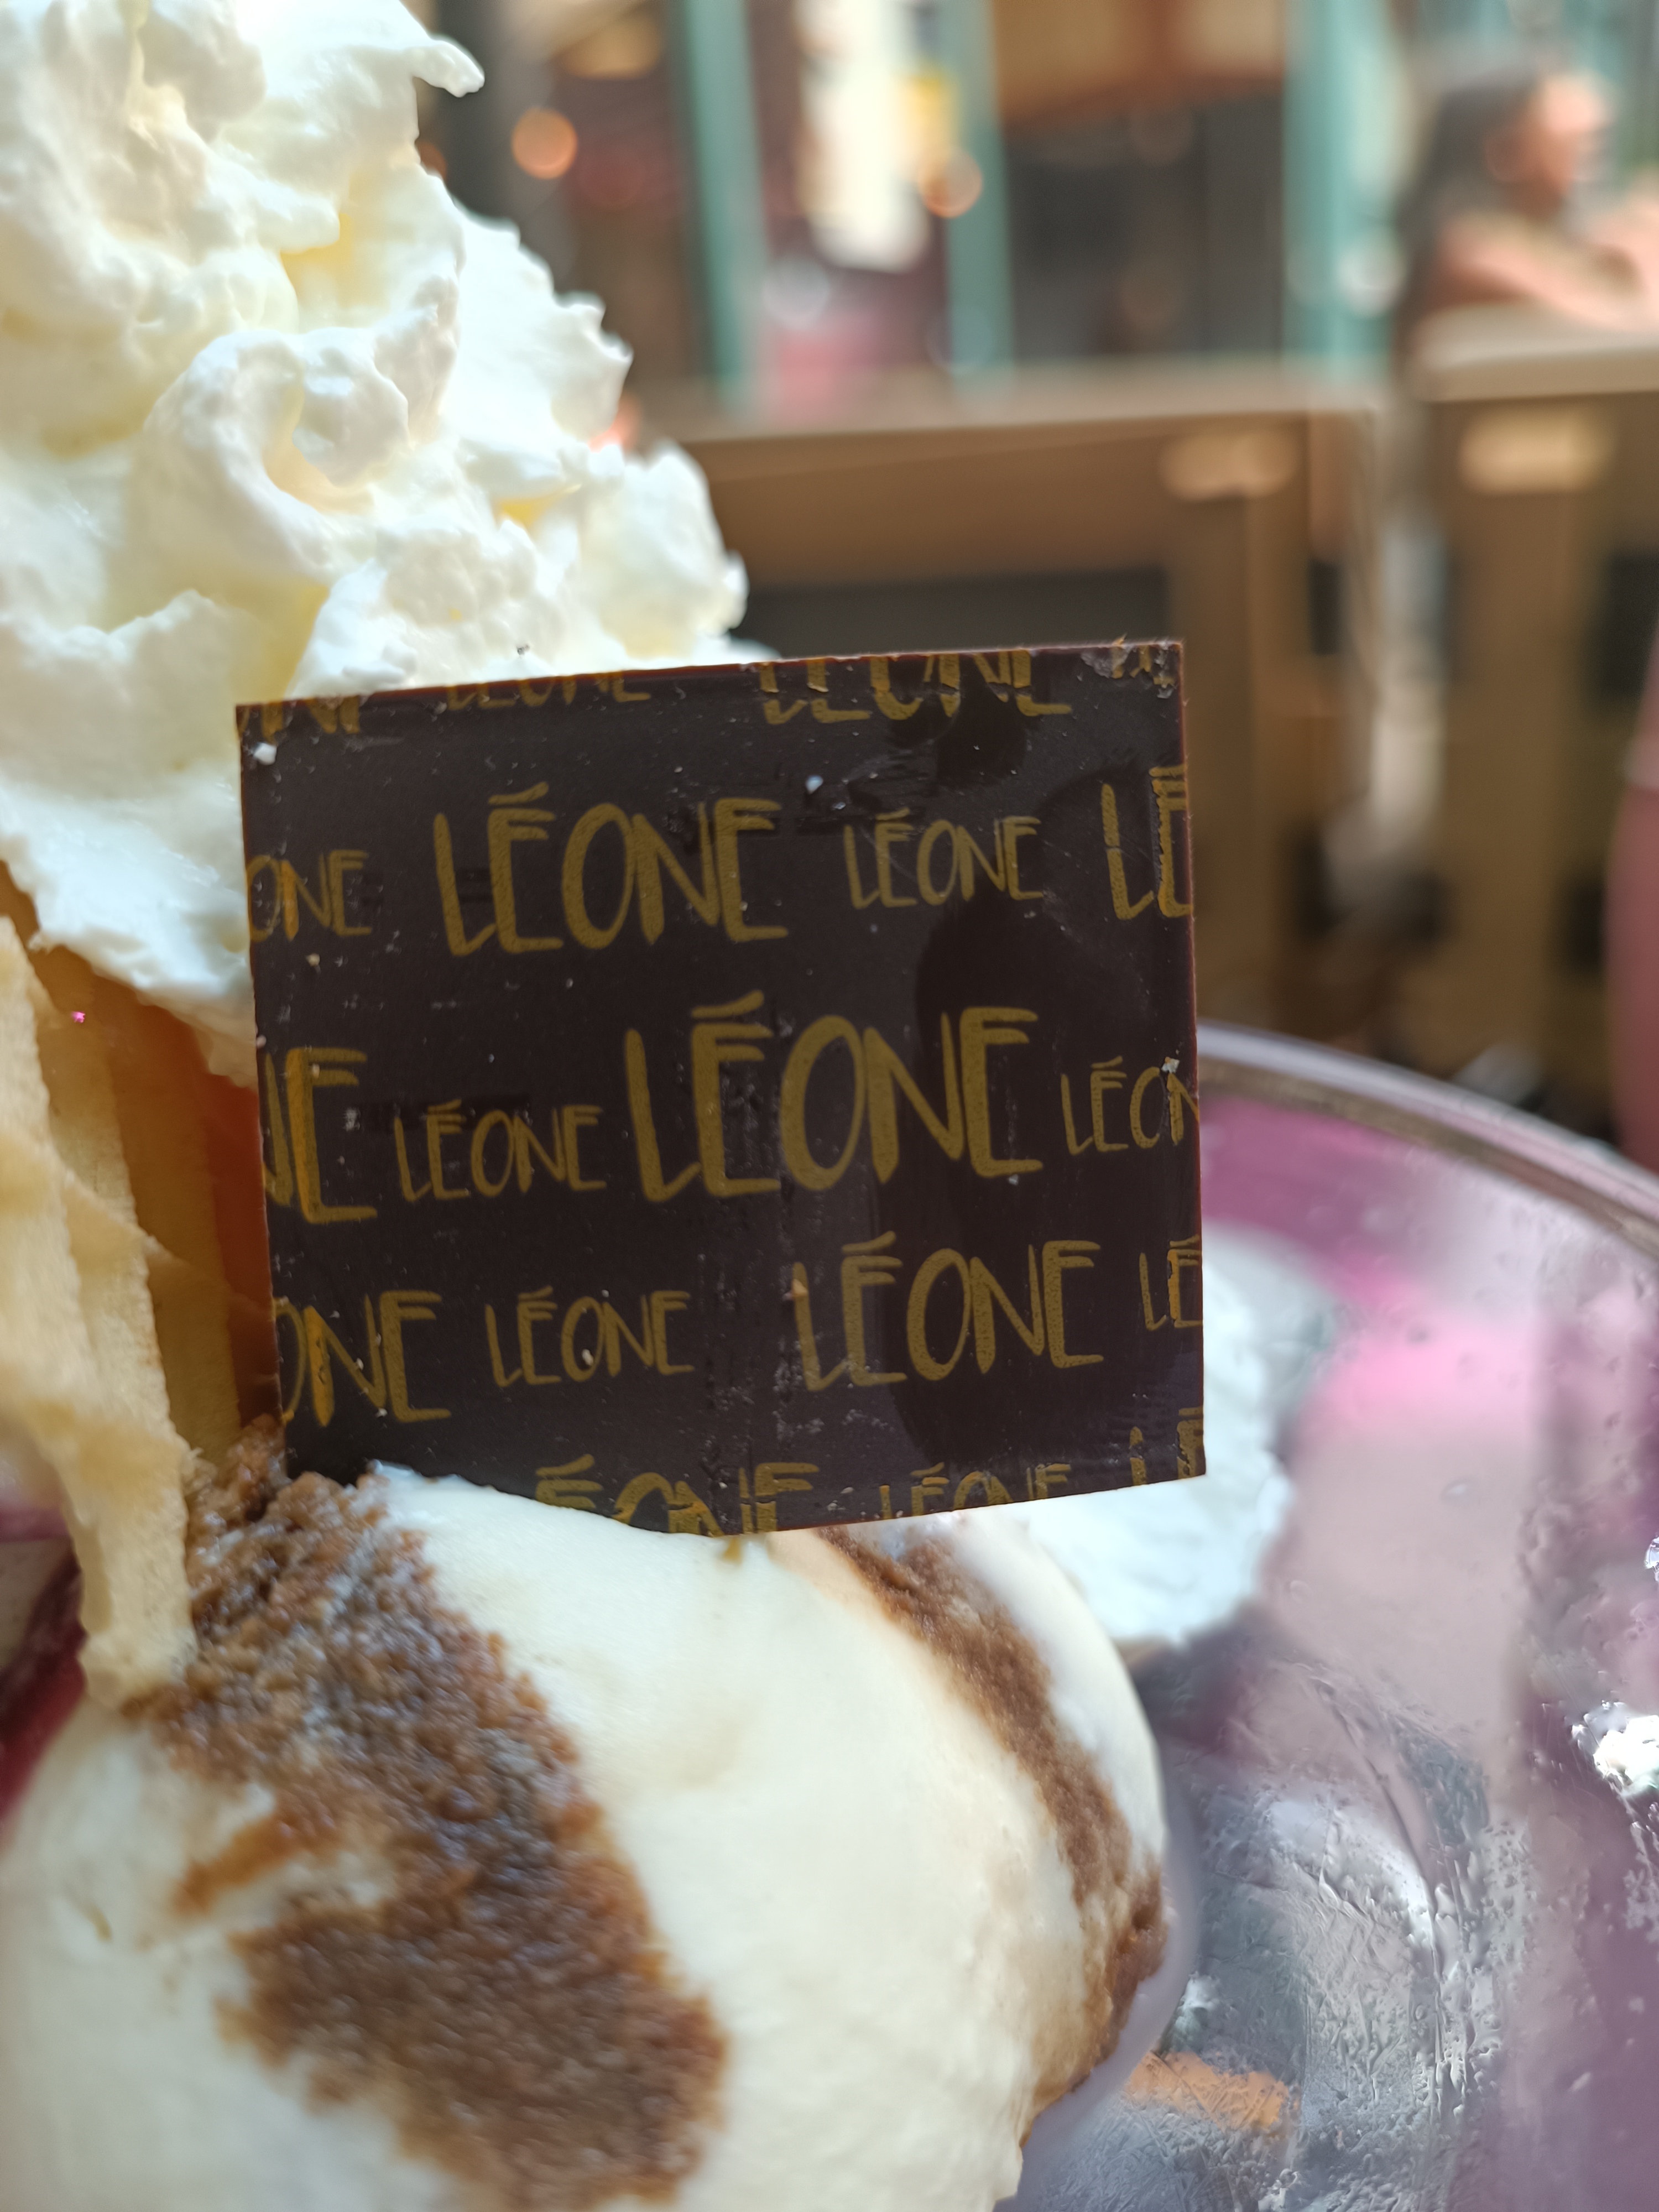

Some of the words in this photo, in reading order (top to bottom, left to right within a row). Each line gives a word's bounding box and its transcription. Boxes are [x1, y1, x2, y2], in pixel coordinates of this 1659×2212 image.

[433, 781, 789, 957] LÉONE
[843, 807, 1044, 909] LÉONE
[394, 1099, 607, 1202] LÉONE
[624, 989, 1044, 1203] LÉONE
[485, 1286, 695, 1388] LÉONE
[791, 1230, 1105, 1391] LÉONE
